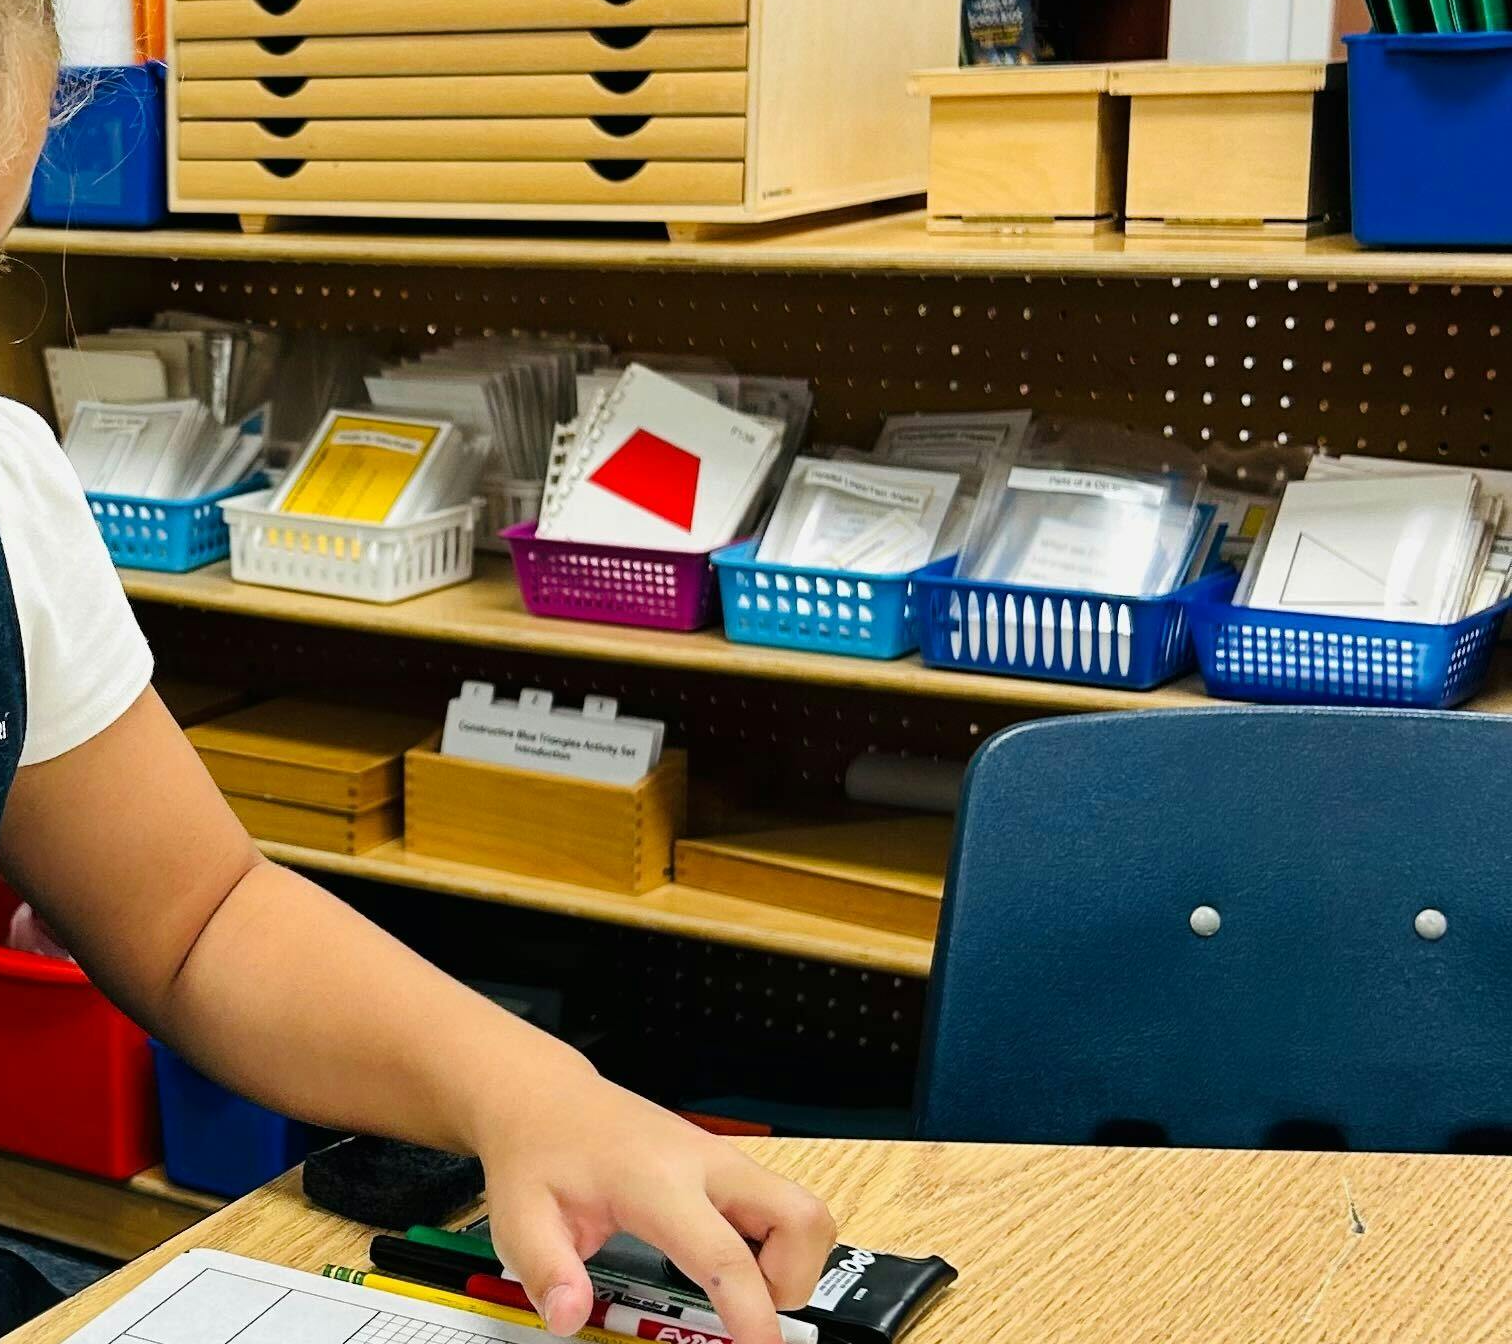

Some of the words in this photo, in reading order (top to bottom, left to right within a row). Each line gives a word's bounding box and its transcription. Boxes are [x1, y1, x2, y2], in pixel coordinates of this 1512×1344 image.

[514, 743, 571, 761] Introduction
[517, 729, 537, 742] Blue
[540, 733, 581, 749] Triangles
[584, 737, 617, 756] Activity
